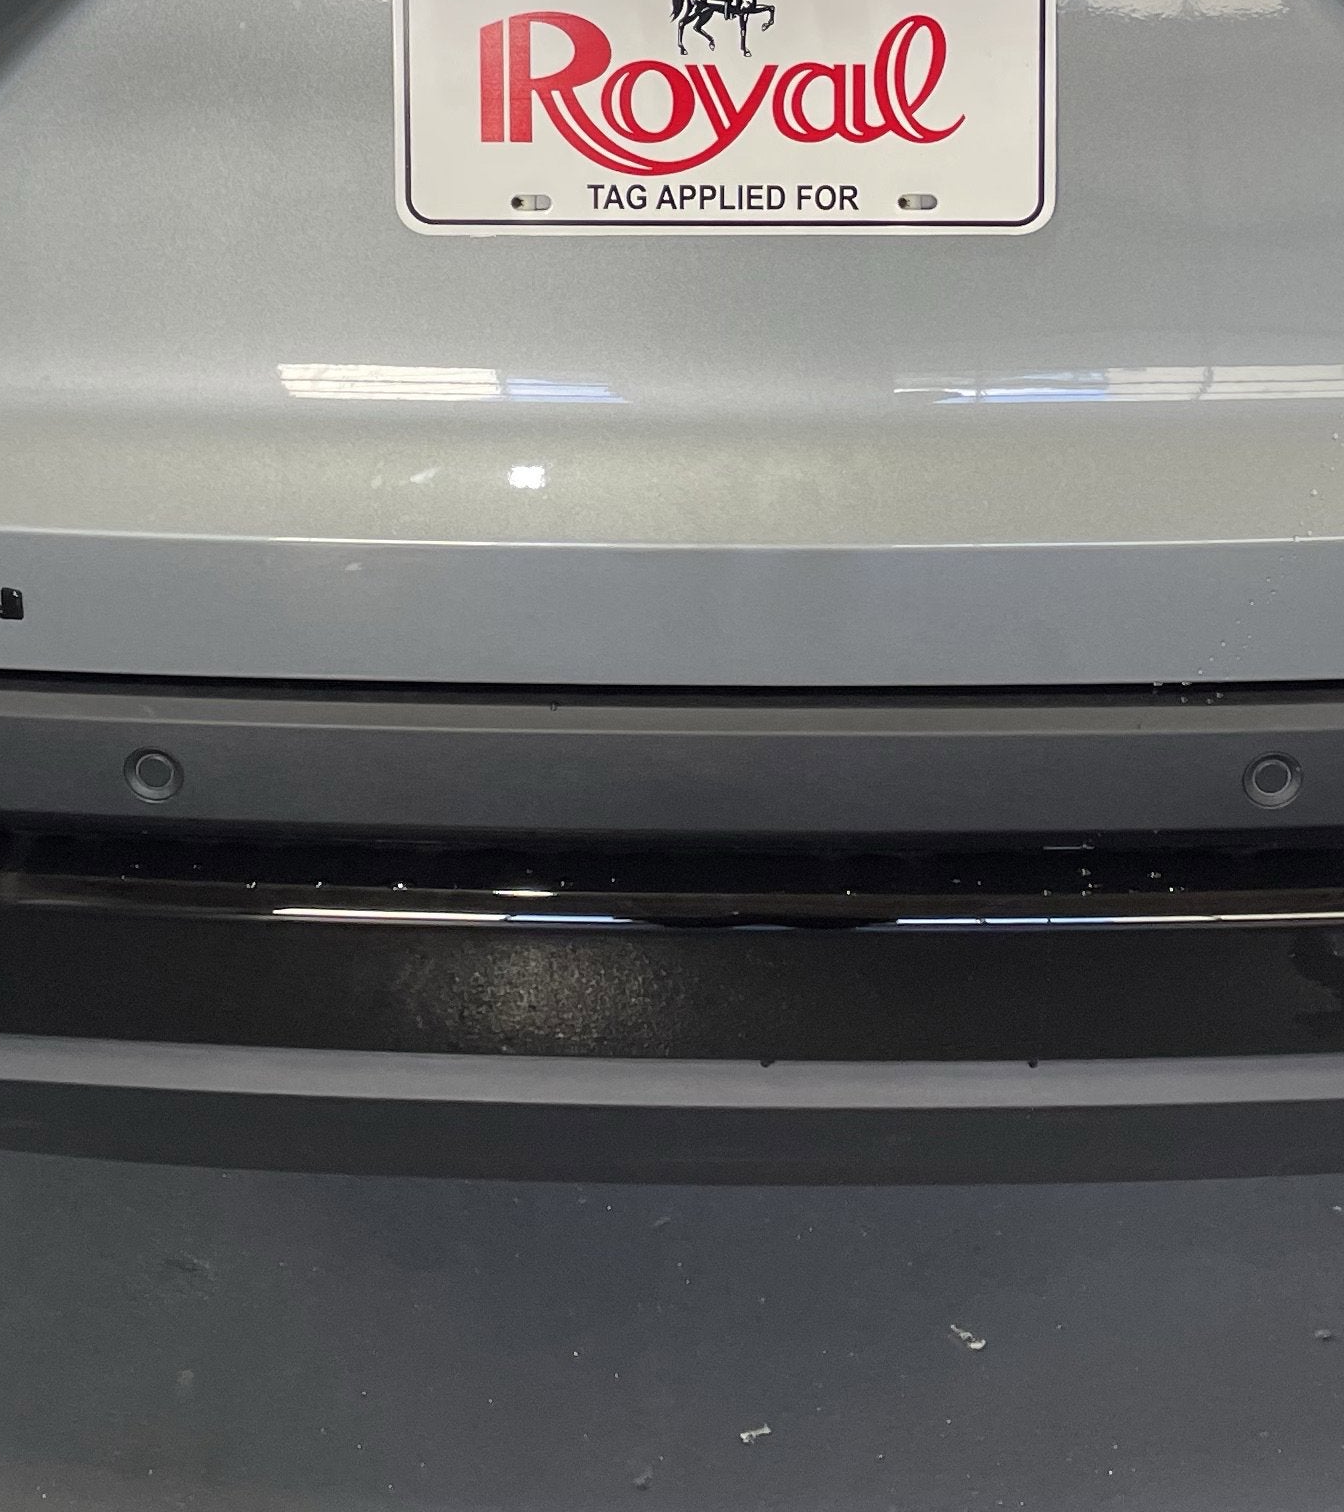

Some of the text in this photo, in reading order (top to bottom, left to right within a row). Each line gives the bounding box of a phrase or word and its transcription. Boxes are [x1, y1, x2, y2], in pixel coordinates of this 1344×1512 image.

[479, 10, 966, 176] Royal
[587, 185, 859, 211] TAG APPLIED FOR
